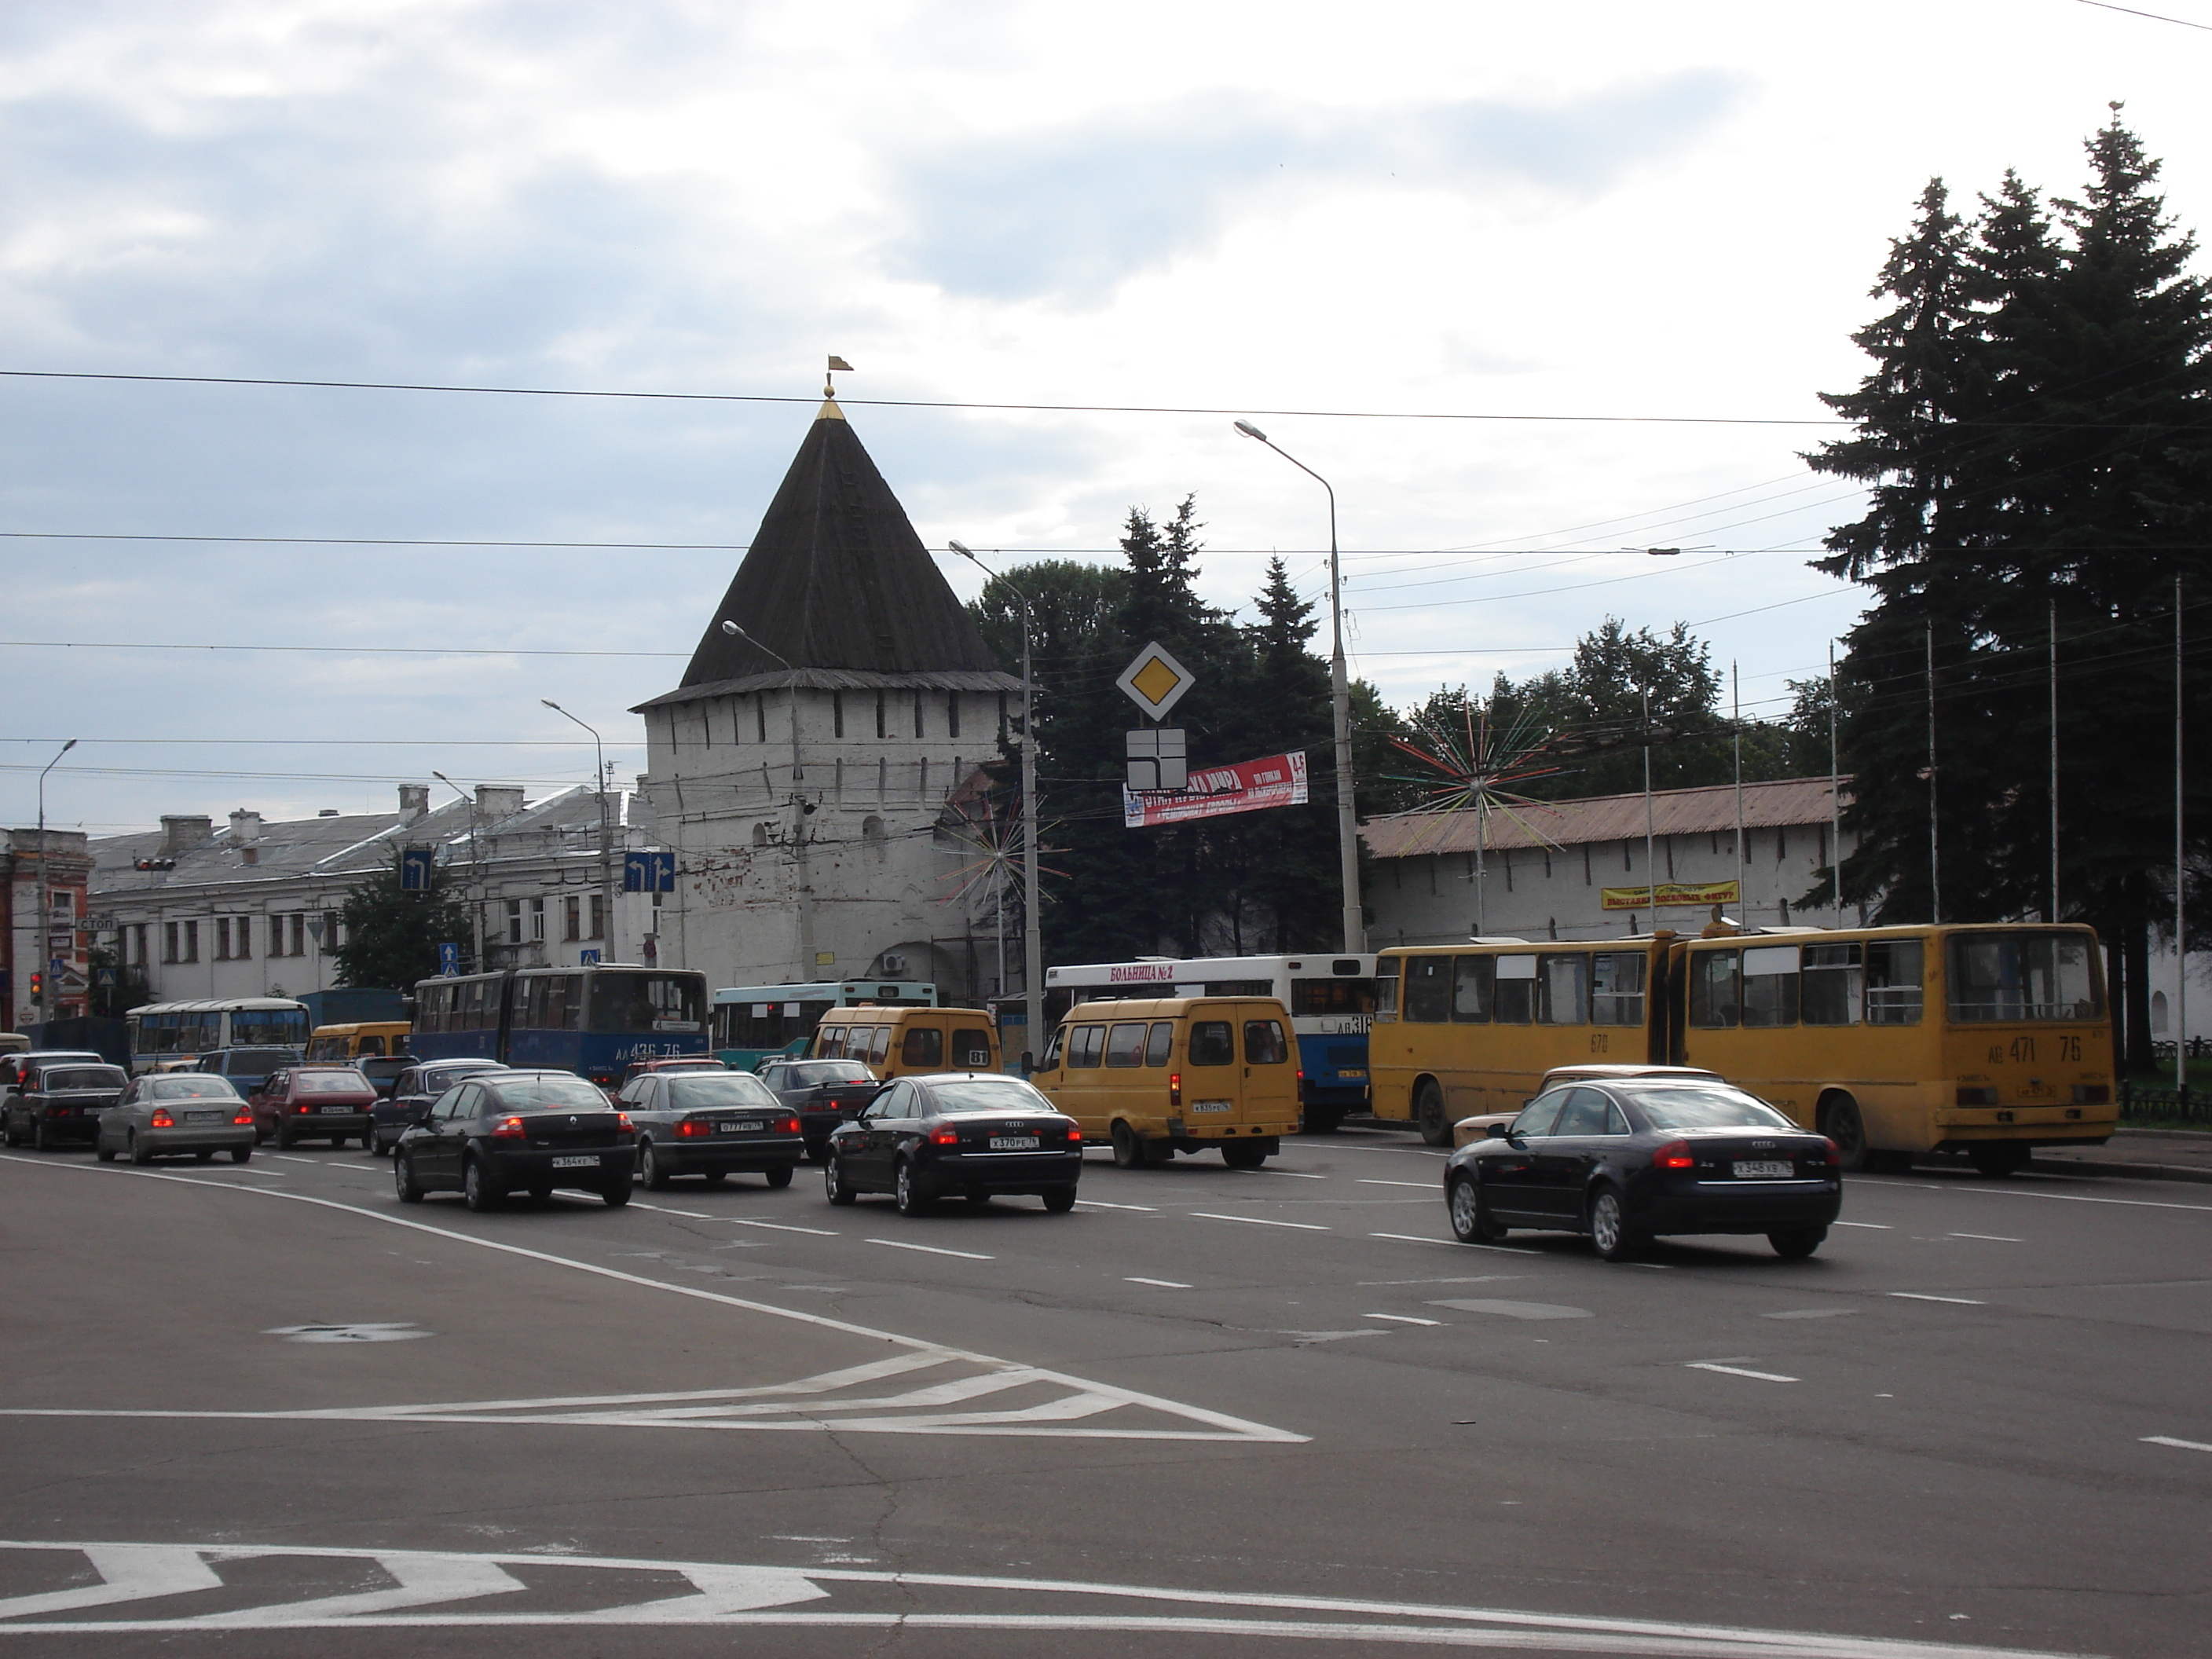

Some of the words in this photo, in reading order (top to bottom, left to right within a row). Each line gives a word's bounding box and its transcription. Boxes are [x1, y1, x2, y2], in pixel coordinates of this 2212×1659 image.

[1704, 891, 1734, 901] ФИГУР
[81, 919, 113, 930] СТОП
[1110, 965, 1156, 982] БОЛЬНИЦА
[630, 1042, 657, 1061] 436
[663, 1043, 680, 1060] 76
[1591, 1034, 1608, 1053] 670
[2009, 1036, 2035, 1063] 471
[2059, 1035, 2081, 1062] 76
[970, 1051, 987, 1064] 81
